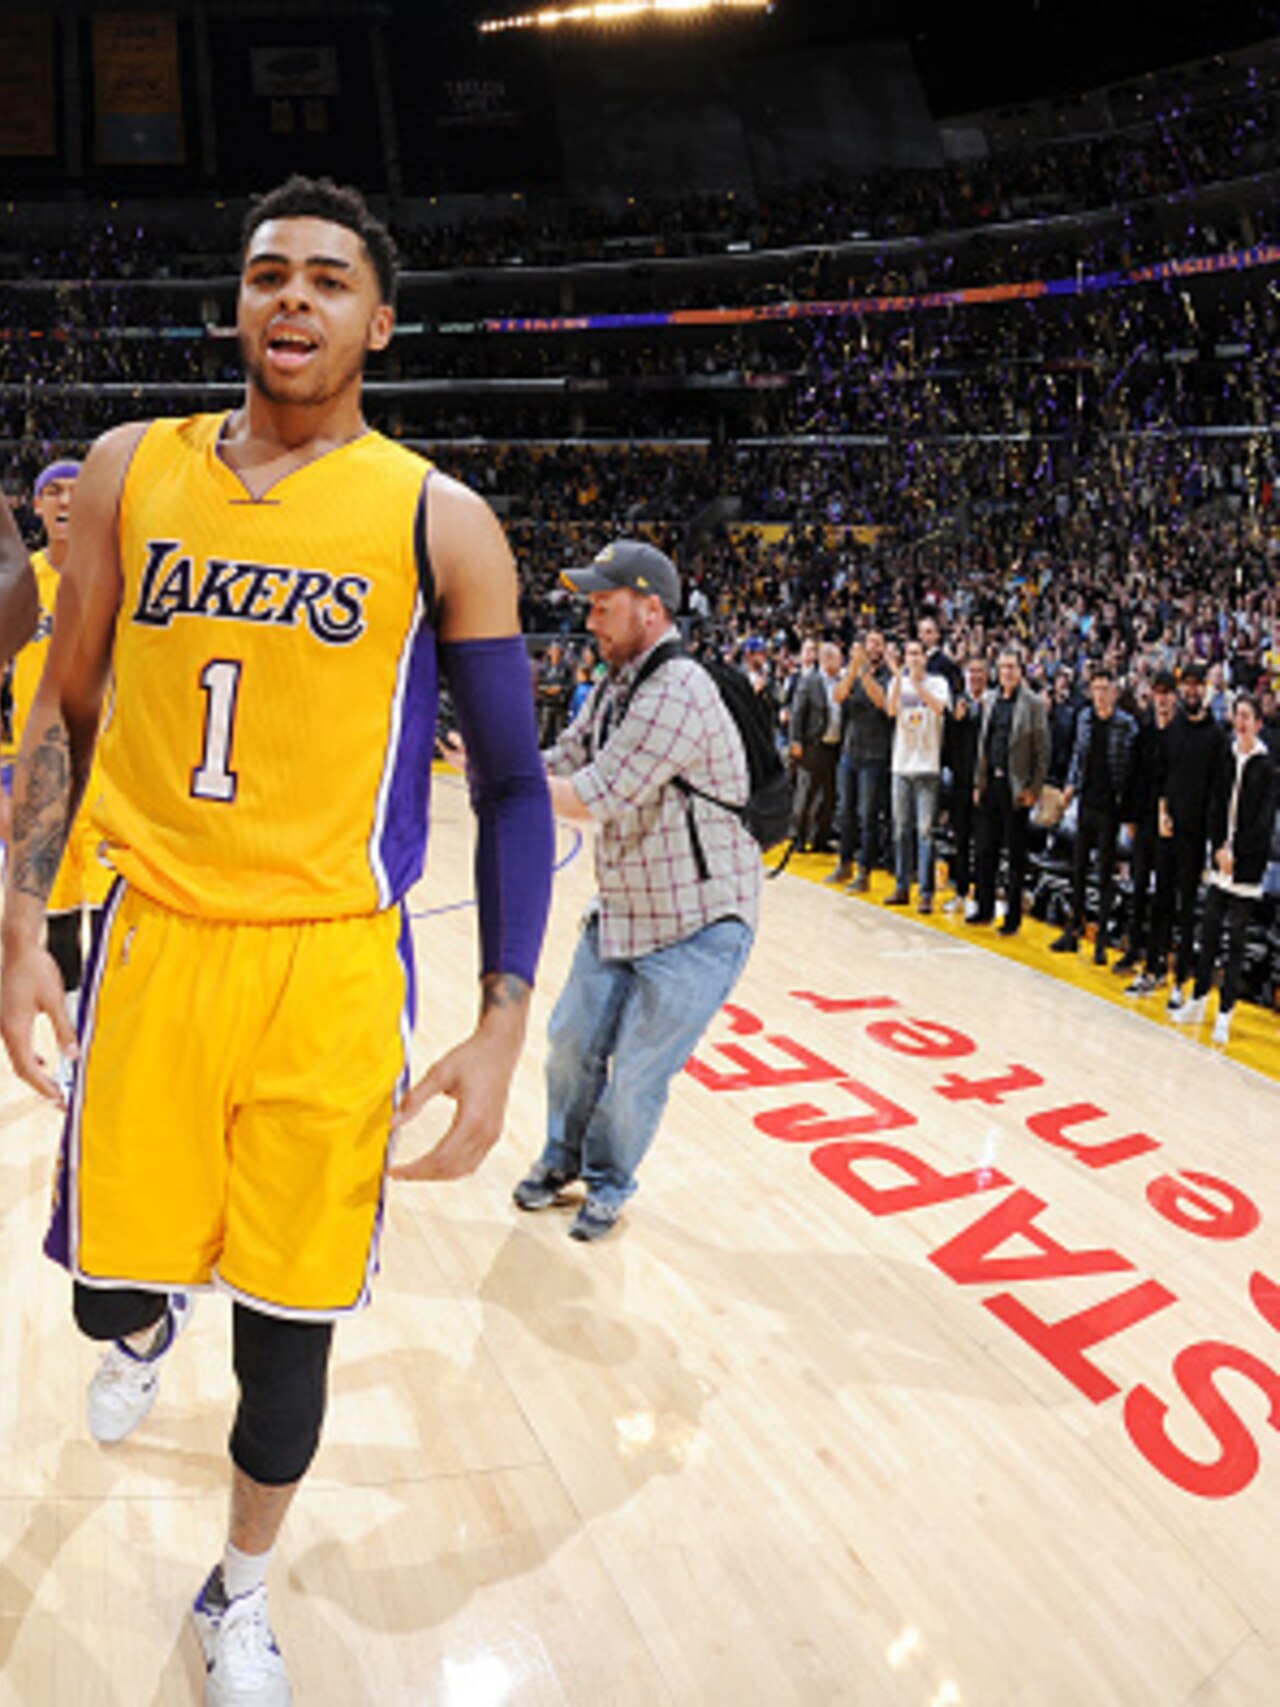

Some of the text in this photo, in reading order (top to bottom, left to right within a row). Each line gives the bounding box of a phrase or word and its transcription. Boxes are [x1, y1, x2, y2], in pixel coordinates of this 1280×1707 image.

[131, 540, 370, 646] LAKERS
[189, 658, 243, 803] 1
[682, 1002, 1280, 1498] STAPLE
[788, 990, 1280, 1334] enter
